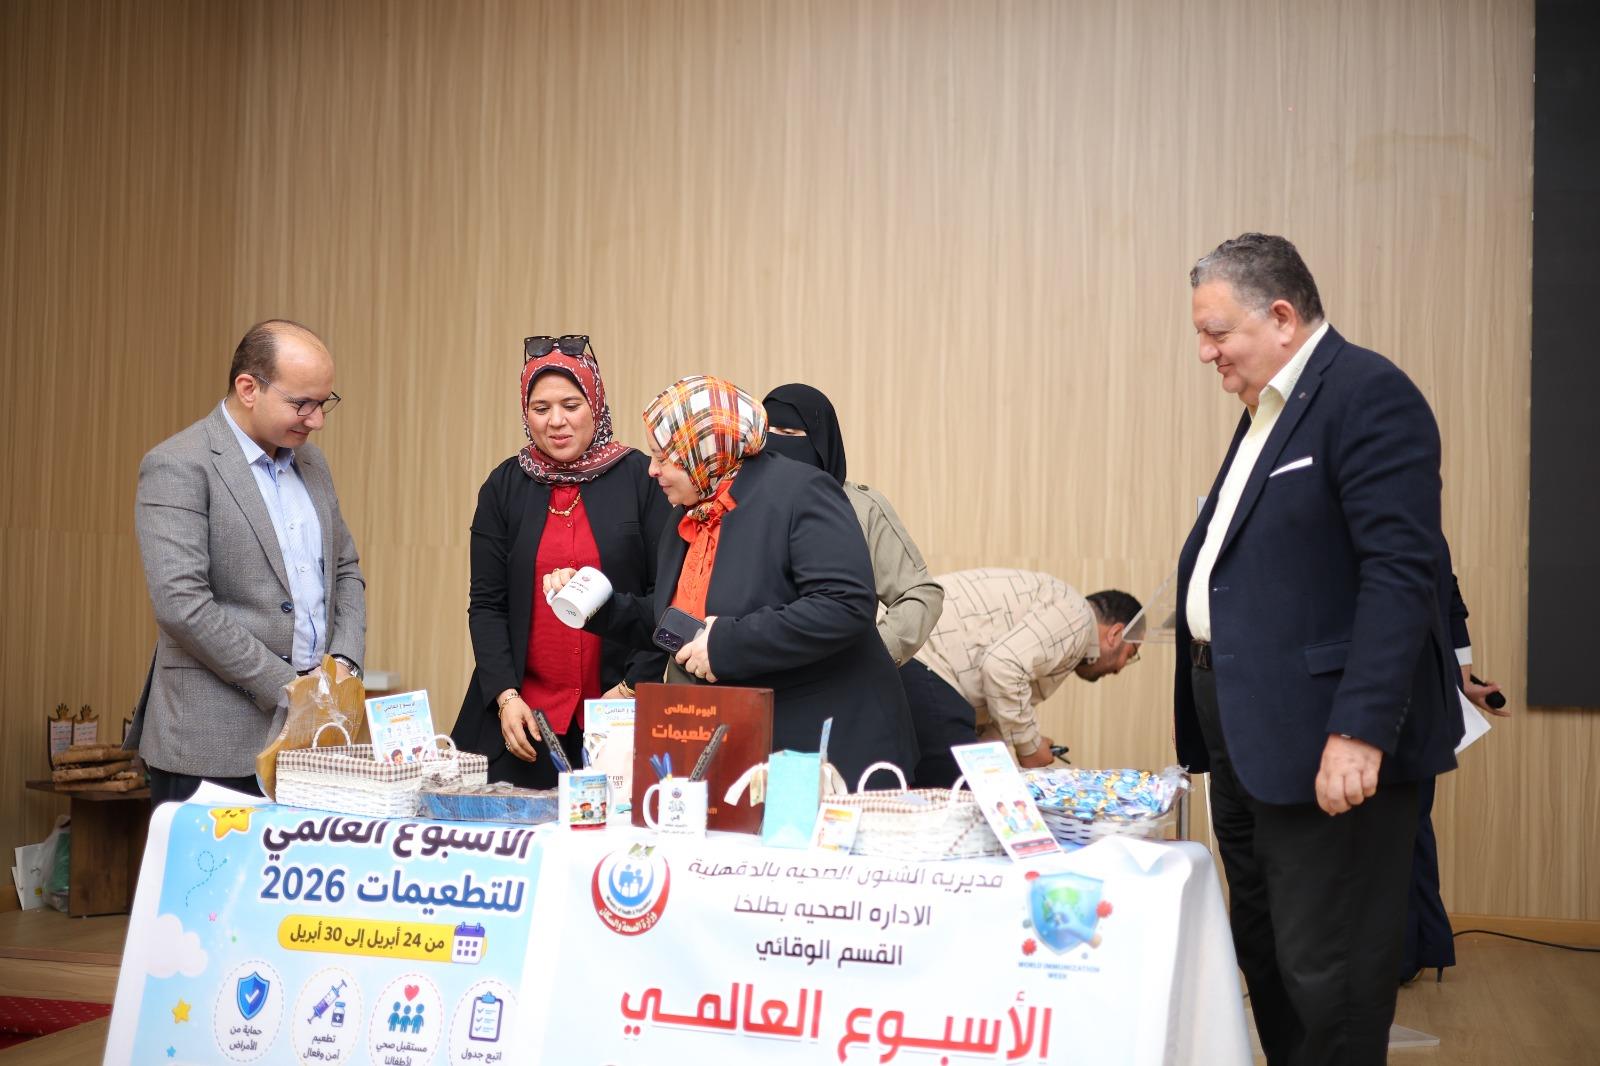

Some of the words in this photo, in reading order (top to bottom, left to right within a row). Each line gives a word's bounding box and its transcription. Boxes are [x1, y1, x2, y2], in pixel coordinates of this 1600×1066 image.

[695, 705, 717, 717] اليوم
[652, 724, 728, 742] طعيمات
[262, 816, 391, 861] العالمي
[687, 858, 781, 882] بالدقهلية
[260, 865, 346, 903] 2026
[356, 869, 525, 916] للتطعيمات
[869, 902, 931, 930] الاداره
[290, 921, 323, 943] أبريل
[324, 926, 342, 942] 30
[344, 928, 365, 949] إلى
[367, 927, 401, 950] أبريل
[403, 932, 421, 948] 24
[424, 936, 445, 953] من
[756, 936, 830, 966] الوقائي
[837, 943, 903, 968] القسم
[620, 982, 823, 1039] العالمي
[229, 1025, 242, 1035] من
[242, 1024, 263, 1037] حماية
[837, 990, 1052, 1066] الأسبوع
[229, 1039, 258, 1051] الأمراض
[311, 1033, 336, 1045] تطعيم
[375, 1042, 395, 1053] صحي
[396, 1040, 428, 1053] مستقبل
[302, 1047, 325, 1060] وفعال
[461, 1048, 484, 1061] جدول
[485, 1050, 502, 1064] اتبع
